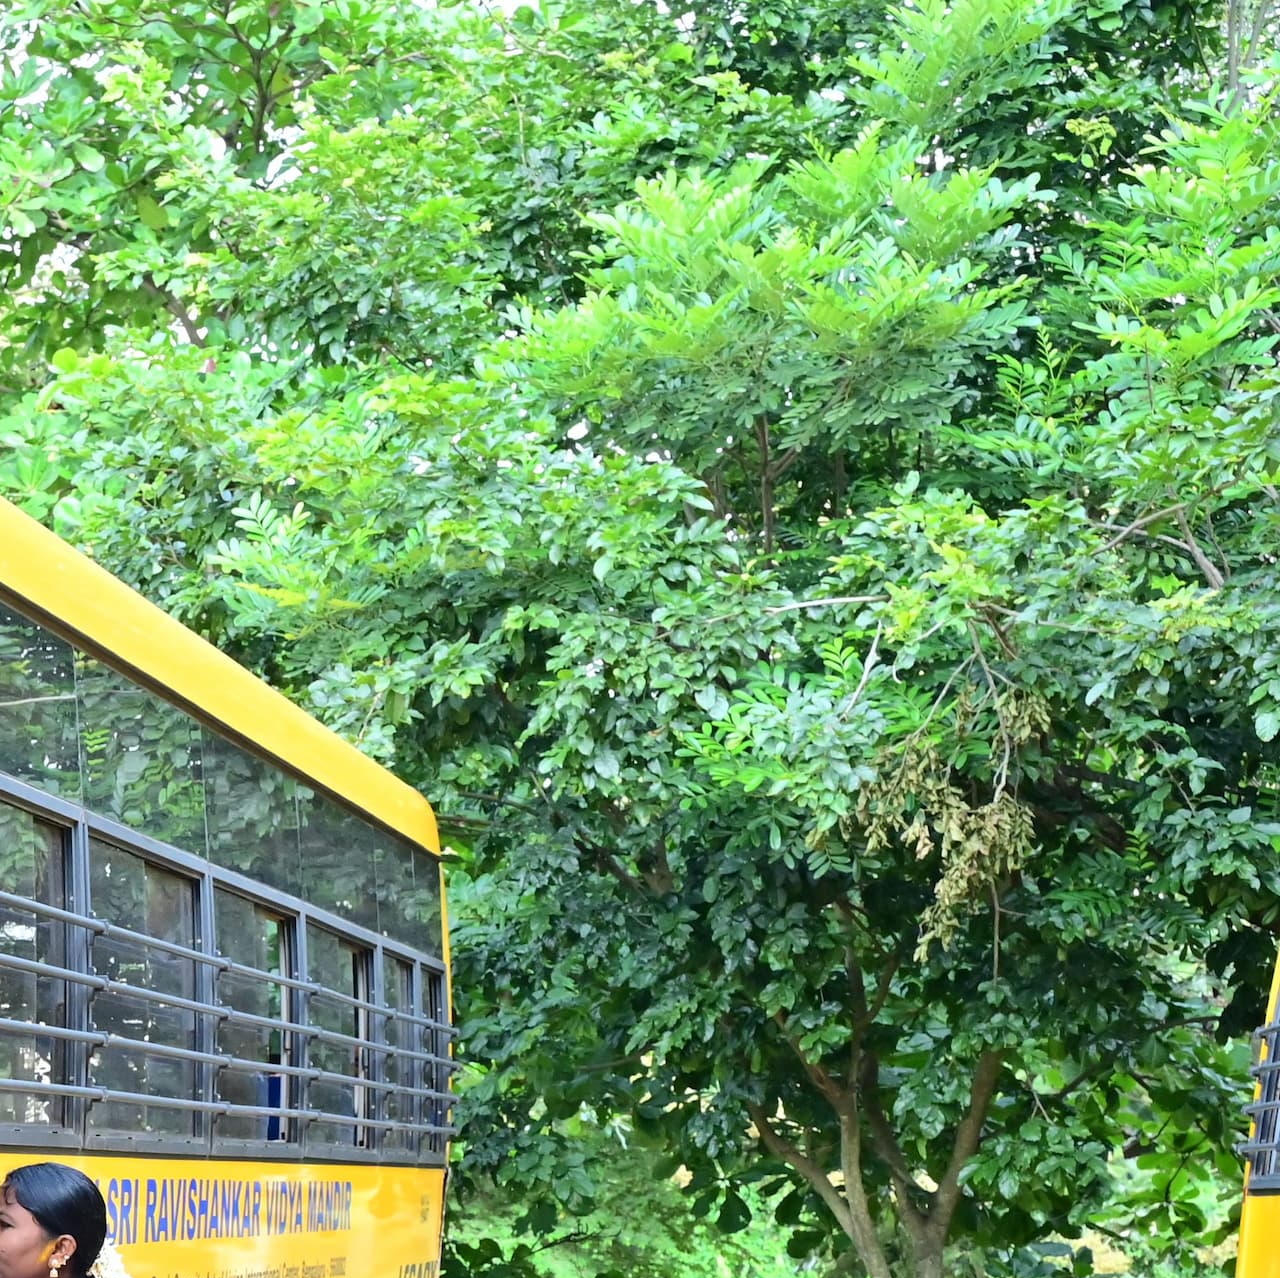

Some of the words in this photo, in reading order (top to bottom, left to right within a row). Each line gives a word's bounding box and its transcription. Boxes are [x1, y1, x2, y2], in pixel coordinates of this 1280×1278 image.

[105, 1178, 139, 1246] SRI
[144, 1178, 261, 1243] RAVISHANKAR
[265, 1180, 303, 1236] VIDYA
[307, 1181, 352, 1232] MANDIR
